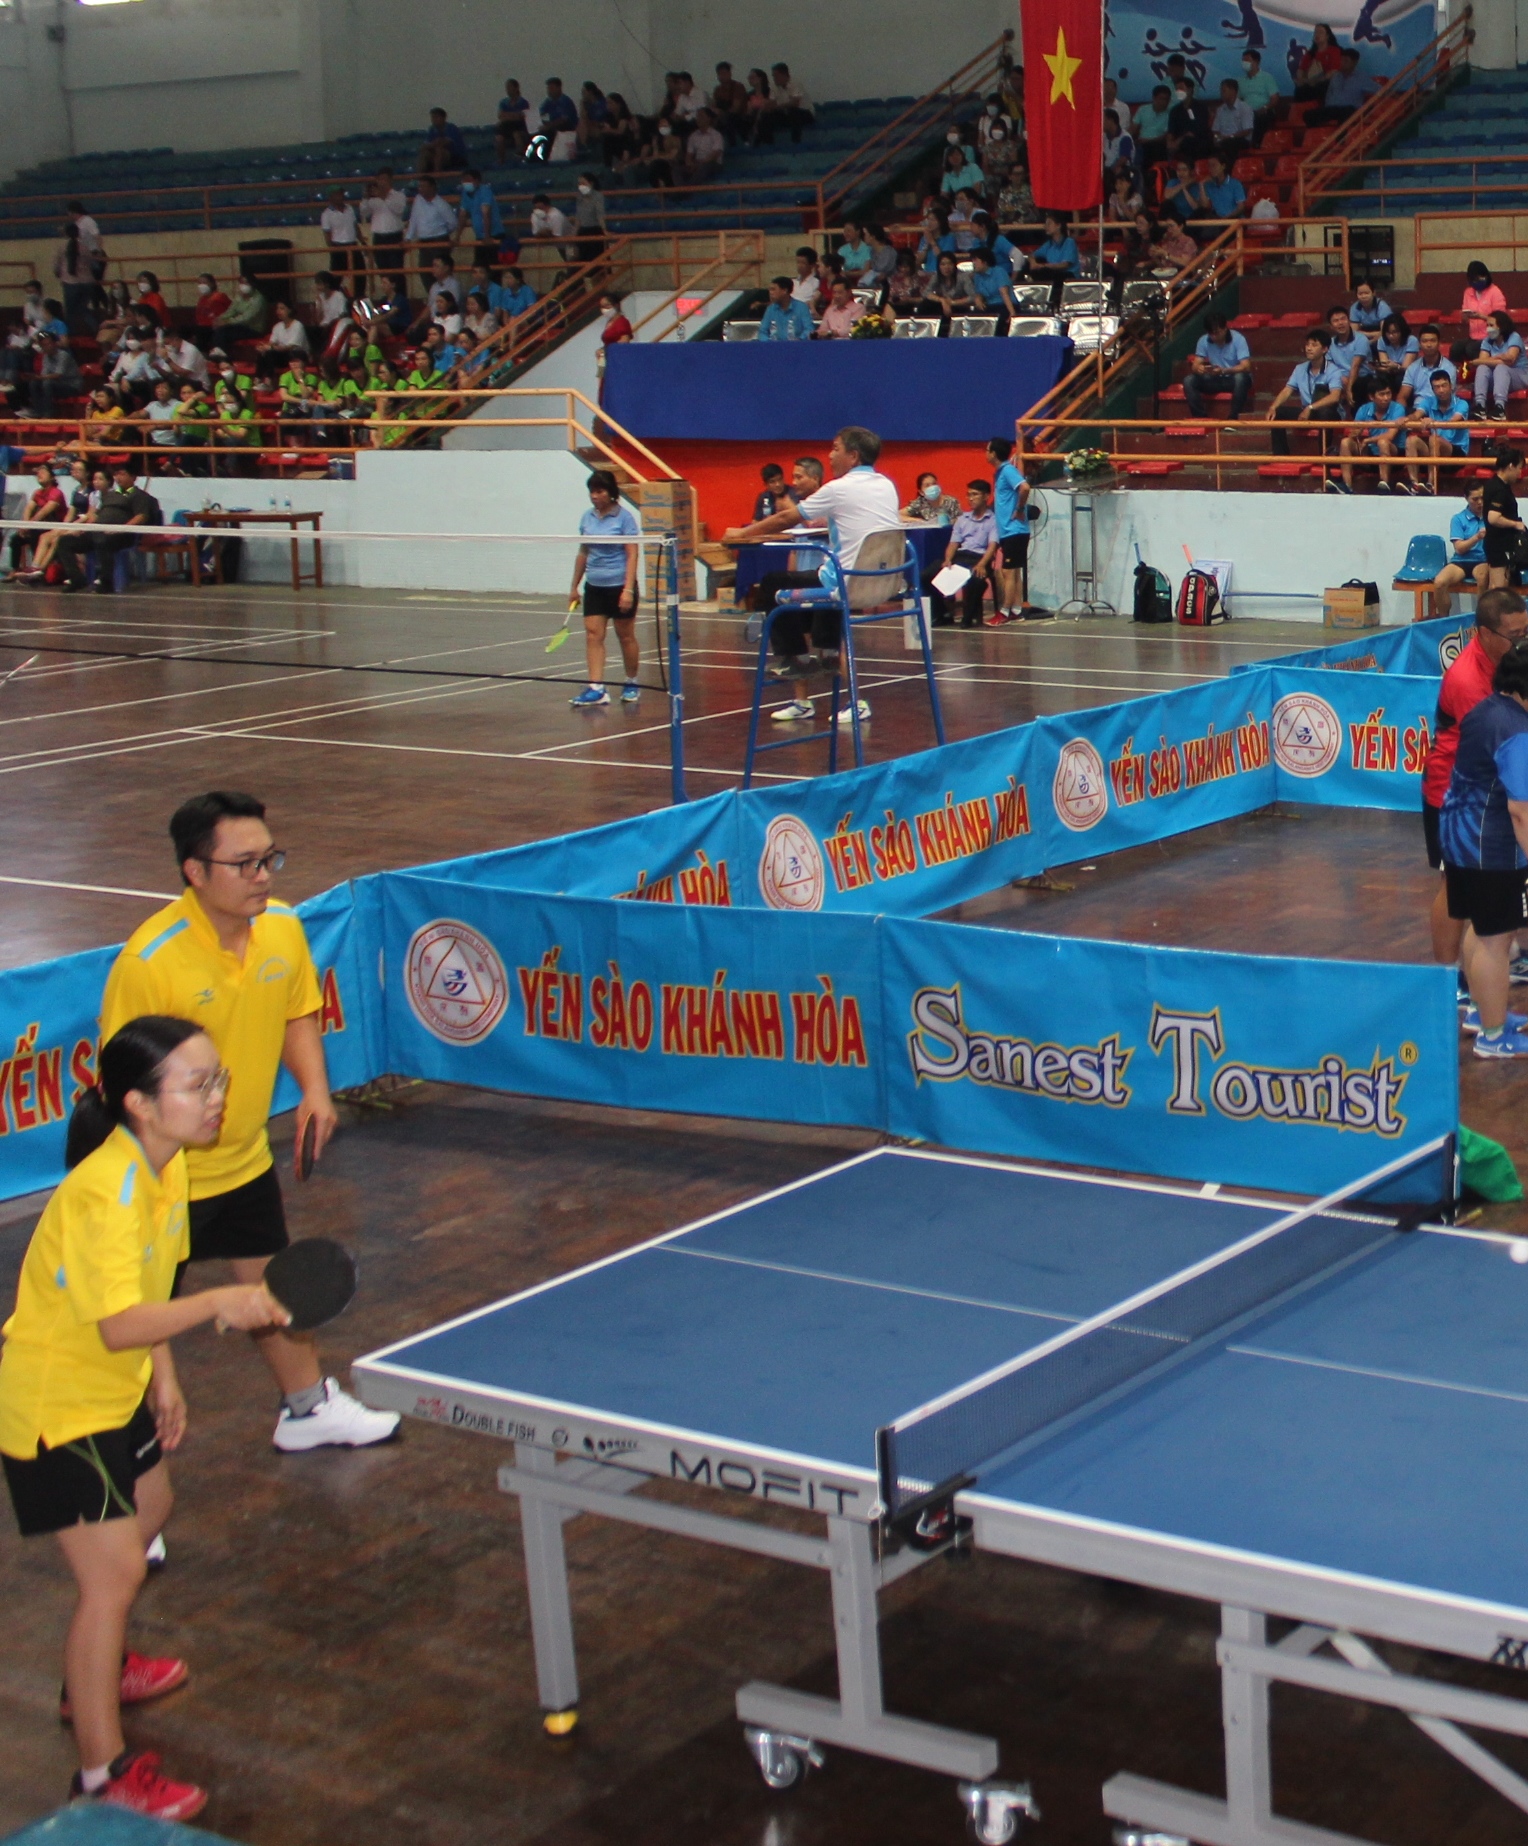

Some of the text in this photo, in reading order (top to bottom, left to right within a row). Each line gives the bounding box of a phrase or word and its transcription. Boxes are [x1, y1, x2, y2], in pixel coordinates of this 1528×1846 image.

[1185, 577, 1196, 614] apacs
[1110, 736, 1145, 808] YẾN
[1148, 735, 1181, 799] SÀO
[1184, 722, 1236, 789] KHÁNH
[1237, 711, 1270, 773] HÒA
[1348, 706, 1398, 772] YẾN
[1402, 715, 1431, 774] SÀ
[823, 811, 874, 894] YẾN
[870, 809, 917, 881] SÀO
[914, 791, 992, 869] KHÁNH
[993, 774, 1031, 846] HÒA
[516, 946, 583, 1043] YẾN
[589, 959, 653, 1053] SÀO
[661, 968, 785, 1061] KHÁNH
[790, 974, 868, 1068] HÒA
[906, 980, 1137, 1108] Sanest
[1148, 1000, 1410, 1140] Tourist
[452, 1404, 505, 1435] DOUBLE
[507, 1420, 536, 1442] FISH
[670, 1448, 859, 1516] MOFIT
